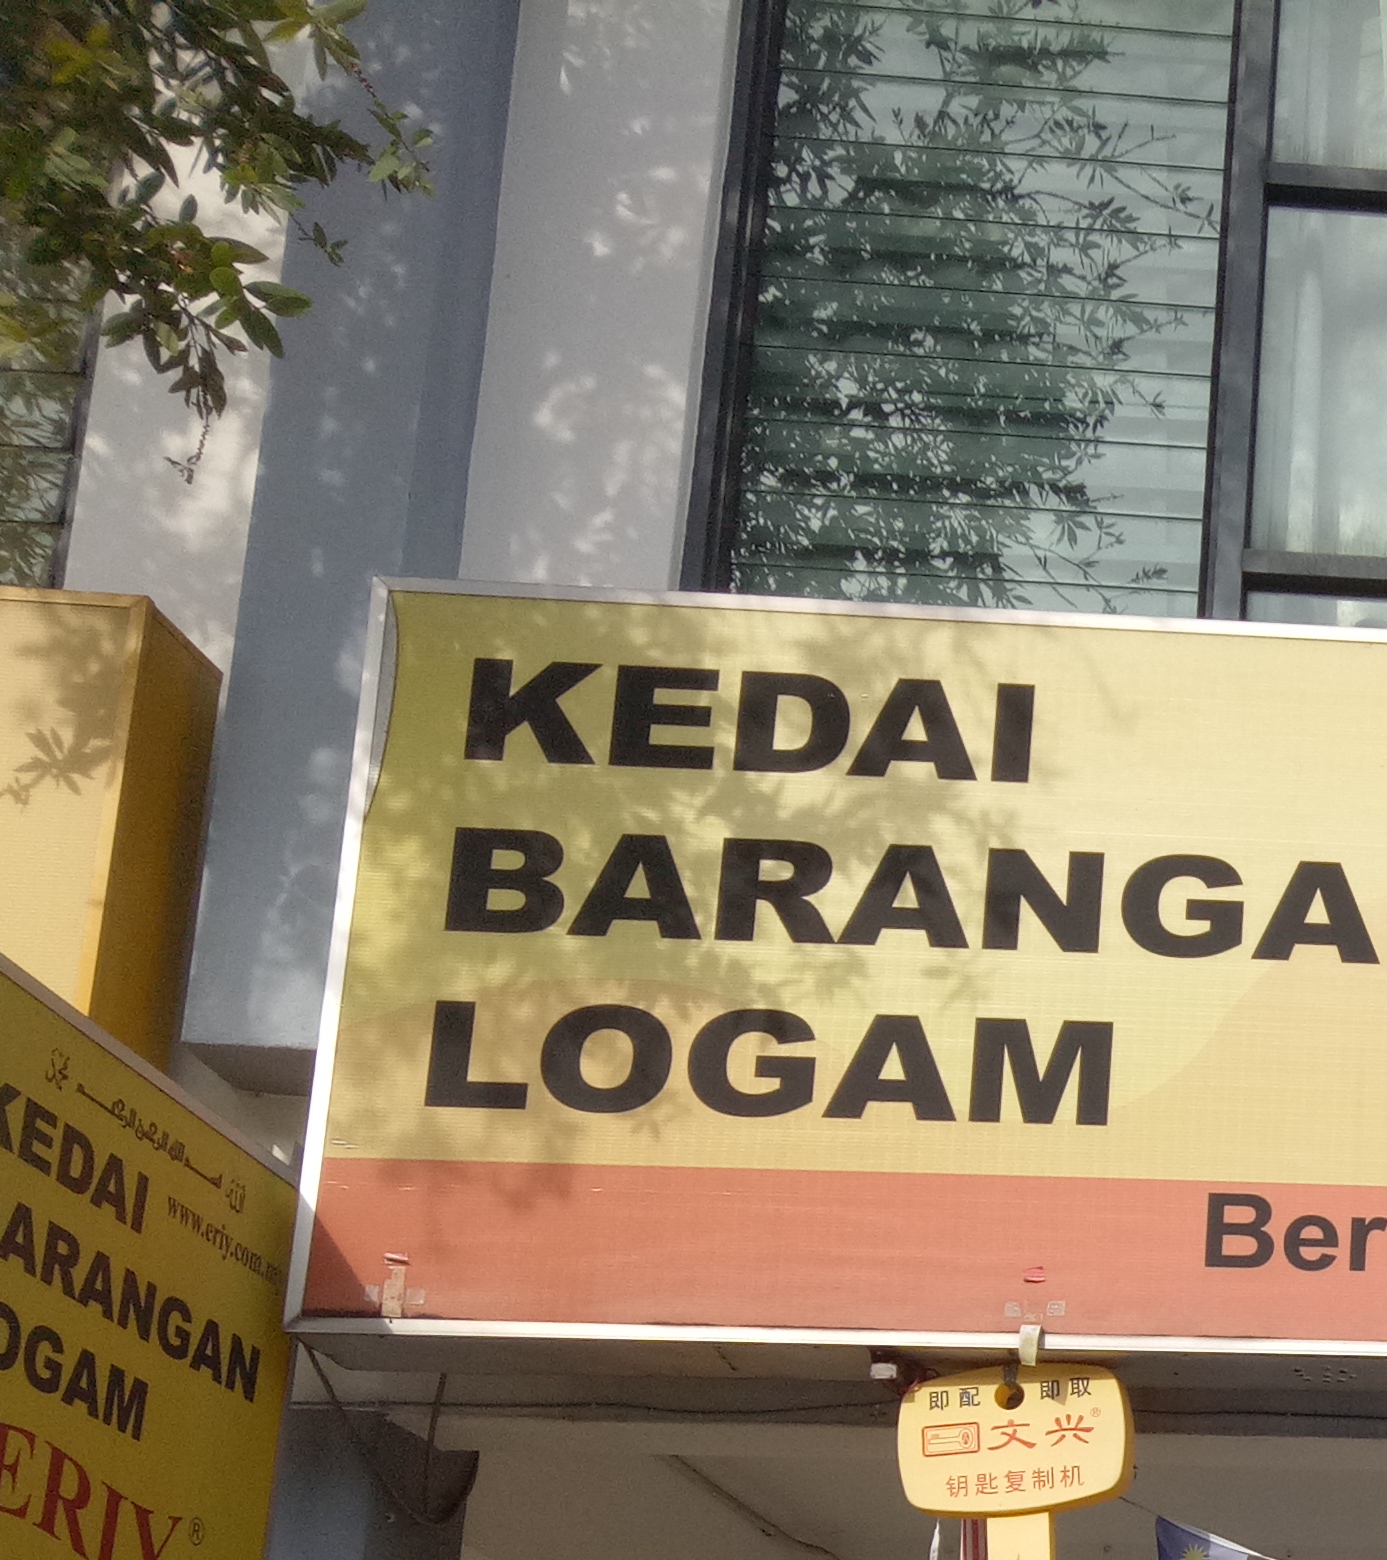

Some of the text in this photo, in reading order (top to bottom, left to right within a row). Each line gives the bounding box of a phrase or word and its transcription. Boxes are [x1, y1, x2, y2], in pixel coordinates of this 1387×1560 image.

[464, 658, 1035, 783] KEDAI
[425, 1001, 1114, 1126] LOGAM
[945, 1465, 1085, 1498] 钥匙复制机
